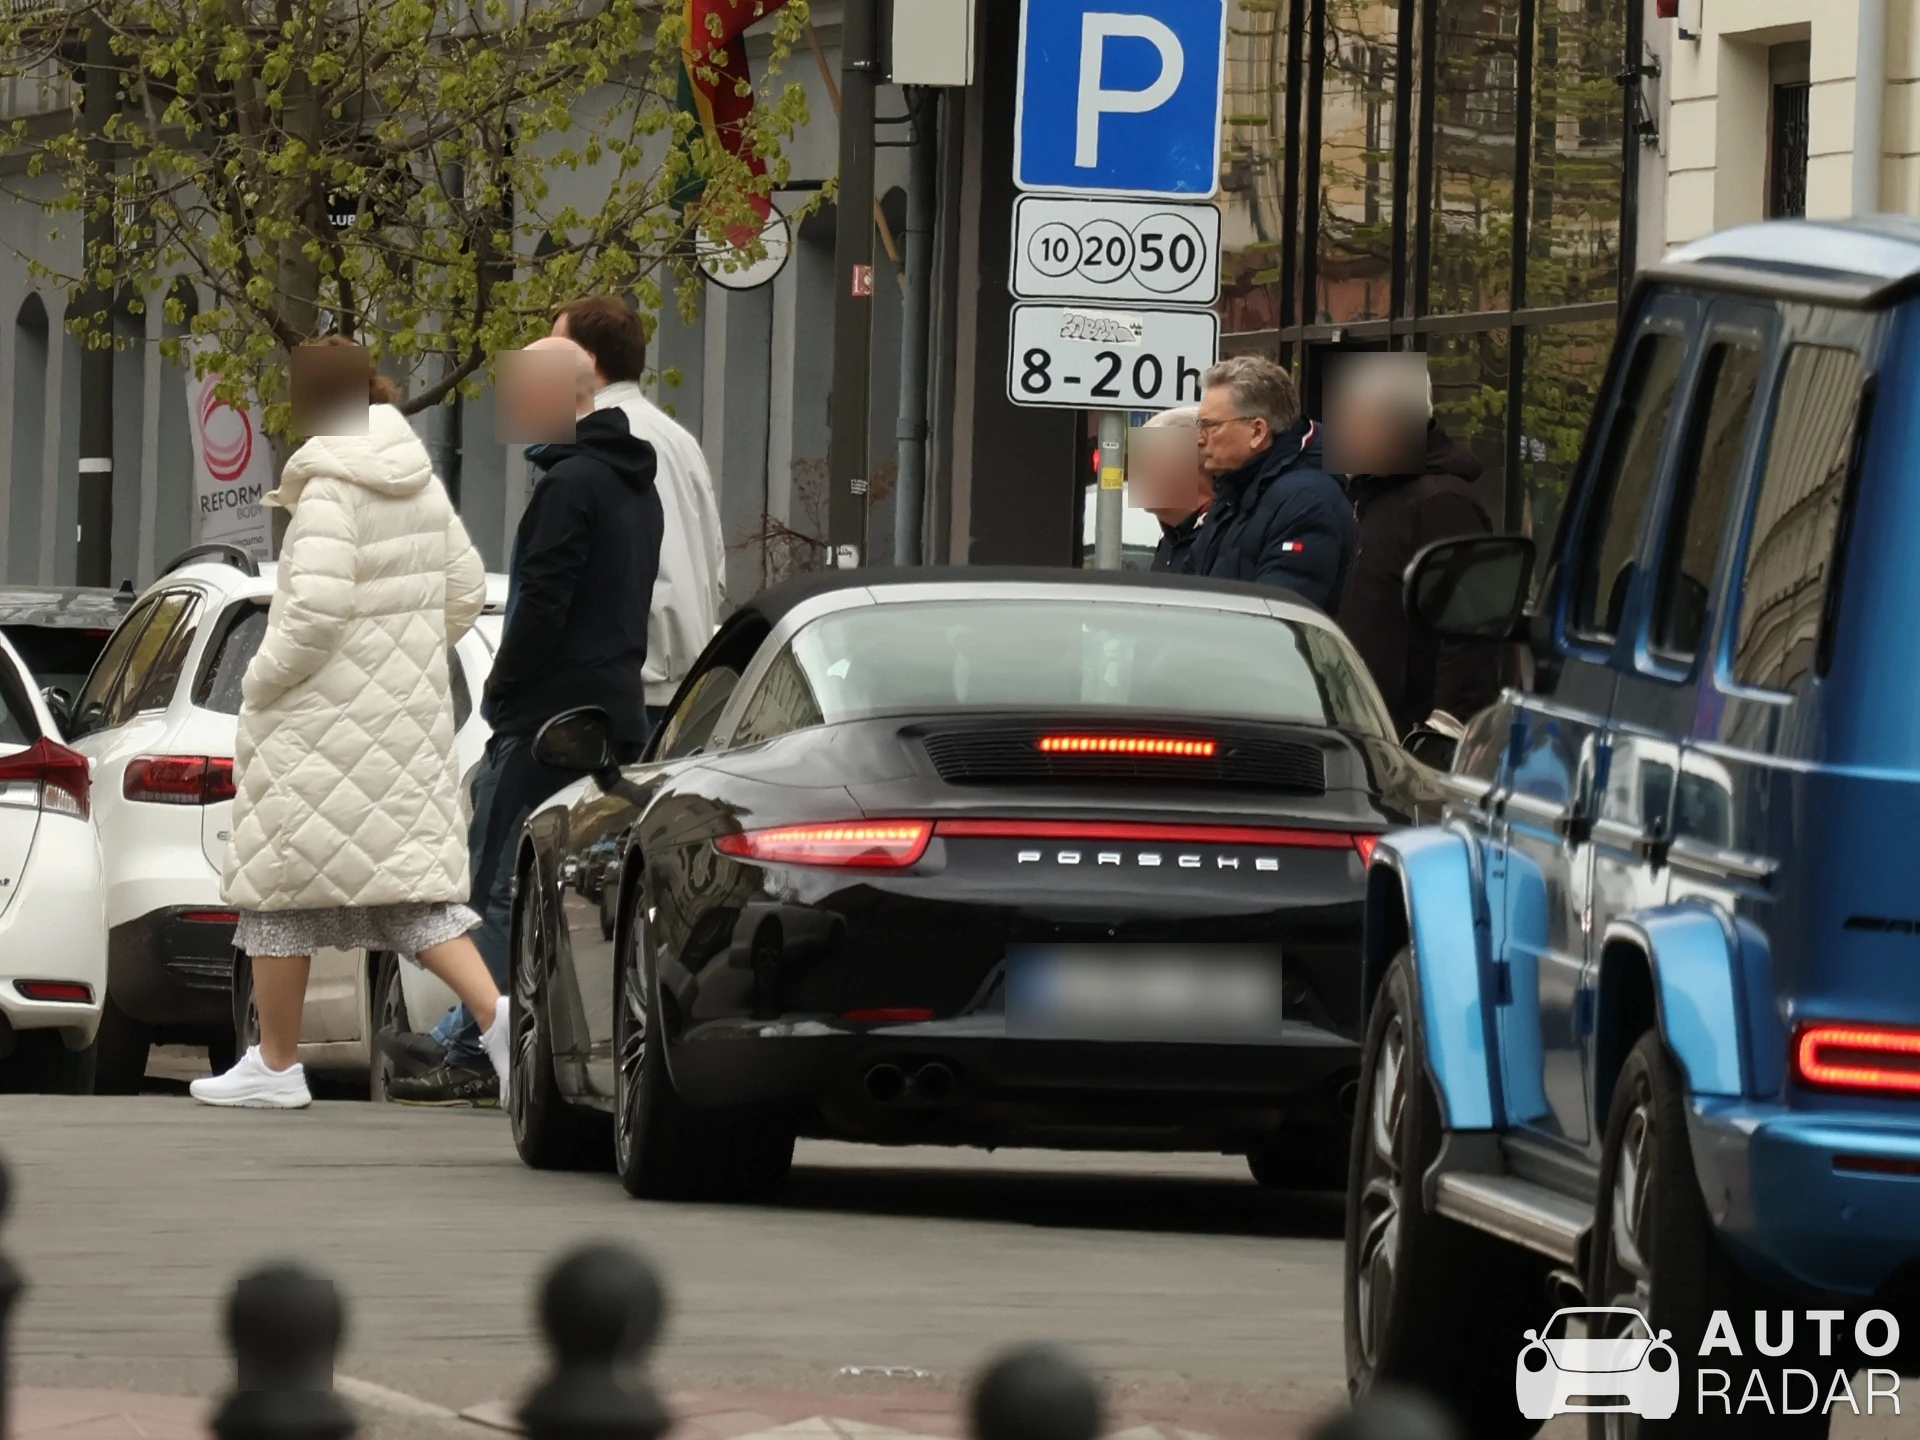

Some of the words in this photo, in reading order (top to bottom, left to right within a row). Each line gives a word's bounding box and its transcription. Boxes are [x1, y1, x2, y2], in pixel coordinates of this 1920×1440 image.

[1075, 12, 1184, 168] P
[1041, 238, 1069, 263] 10
[1083, 236, 1126, 267] 20
[1140, 233, 1196, 274] 50
[200, 483, 262, 513] REFORM
[1018, 850, 1279, 871] PORSCHE
